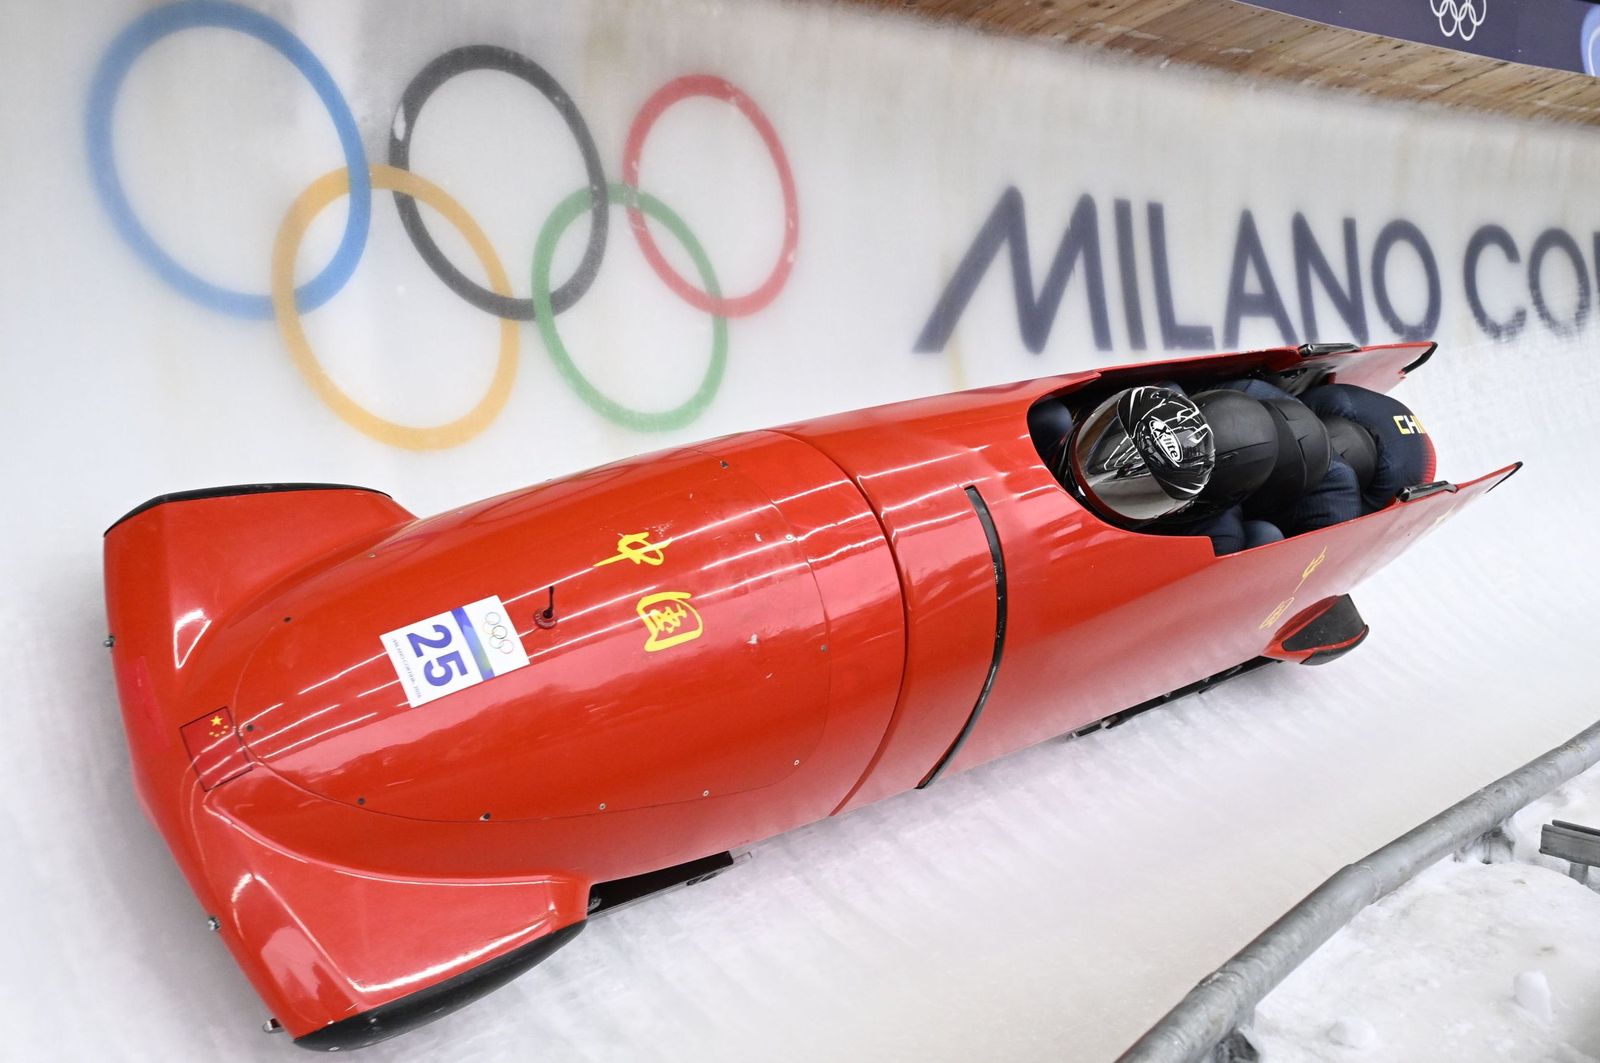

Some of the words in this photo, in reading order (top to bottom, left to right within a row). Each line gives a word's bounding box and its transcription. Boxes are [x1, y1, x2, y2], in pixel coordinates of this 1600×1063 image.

[911, 186, 1442, 354] MILANO
[1463, 224, 1600, 340] CO
[406, 624, 468, 687] 25
